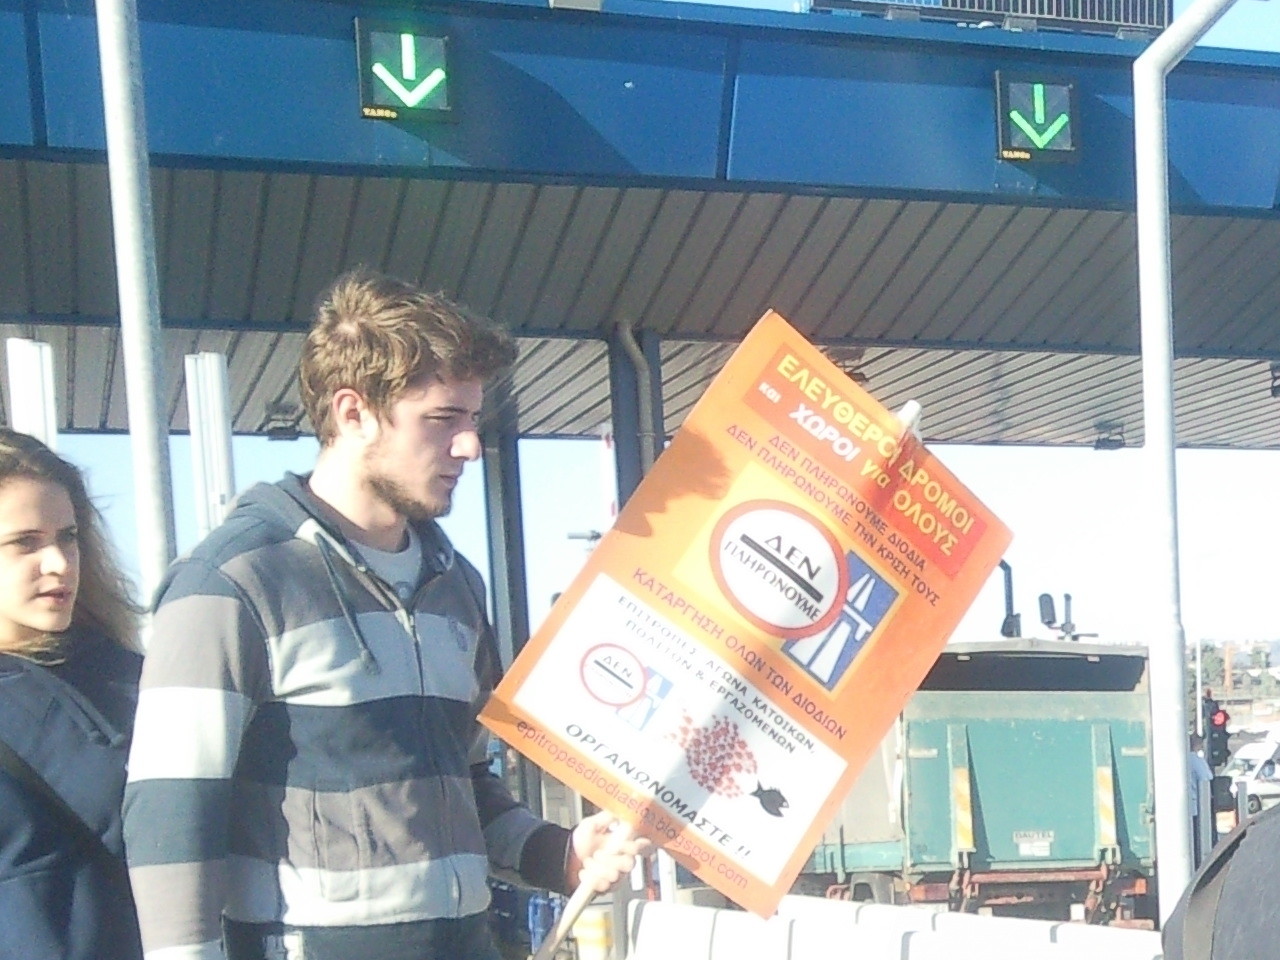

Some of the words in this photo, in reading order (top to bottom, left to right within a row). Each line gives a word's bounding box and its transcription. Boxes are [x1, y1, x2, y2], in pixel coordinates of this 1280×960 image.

[757, 379, 782, 404] και
[788, 399, 861, 465] ΧΩΡΟΙ
[858, 457, 890, 489] για
[889, 486, 959, 557] ΟΛΟΥΣ
[768, 436, 801, 462] ΔΕΝ
[798, 456, 889, 535] ΠΛΗΡΩΝΟΥΜΕ
[886, 530, 928, 572] ΔΙΟΔΙΑ
[897, 461, 975, 535] ΔΡΟΜΟΙ
[725, 425, 758, 451] ΔΕΝ
[756, 445, 853, 526] ΠΛΗΡΩΝΟΥΜΕ
[851, 520, 878, 548] ΤΗΝ
[875, 543, 911, 581] ΚΡΙΣΗ
[907, 573, 941, 607] ΤΟΥΣ
[723, 539, 822, 622] ΠΛΗΡΩΝΟΥΜΕ
[763, 536, 821, 581] ΔΕΝ
[631, 565, 724, 640] ΚΑΤΑΡΓΗΣΗ
[722, 633, 766, 673] ΟΛΩΝ
[763, 666, 793, 696] ΤΩΝ
[791, 690, 847, 740] ΔΙΟΔΙΩΝ
[704, 658, 749, 696] ΑΓΩΝΑ
[707, 678, 796, 755] ΕΡΓΑΖΟΜΕΝΩΝ
